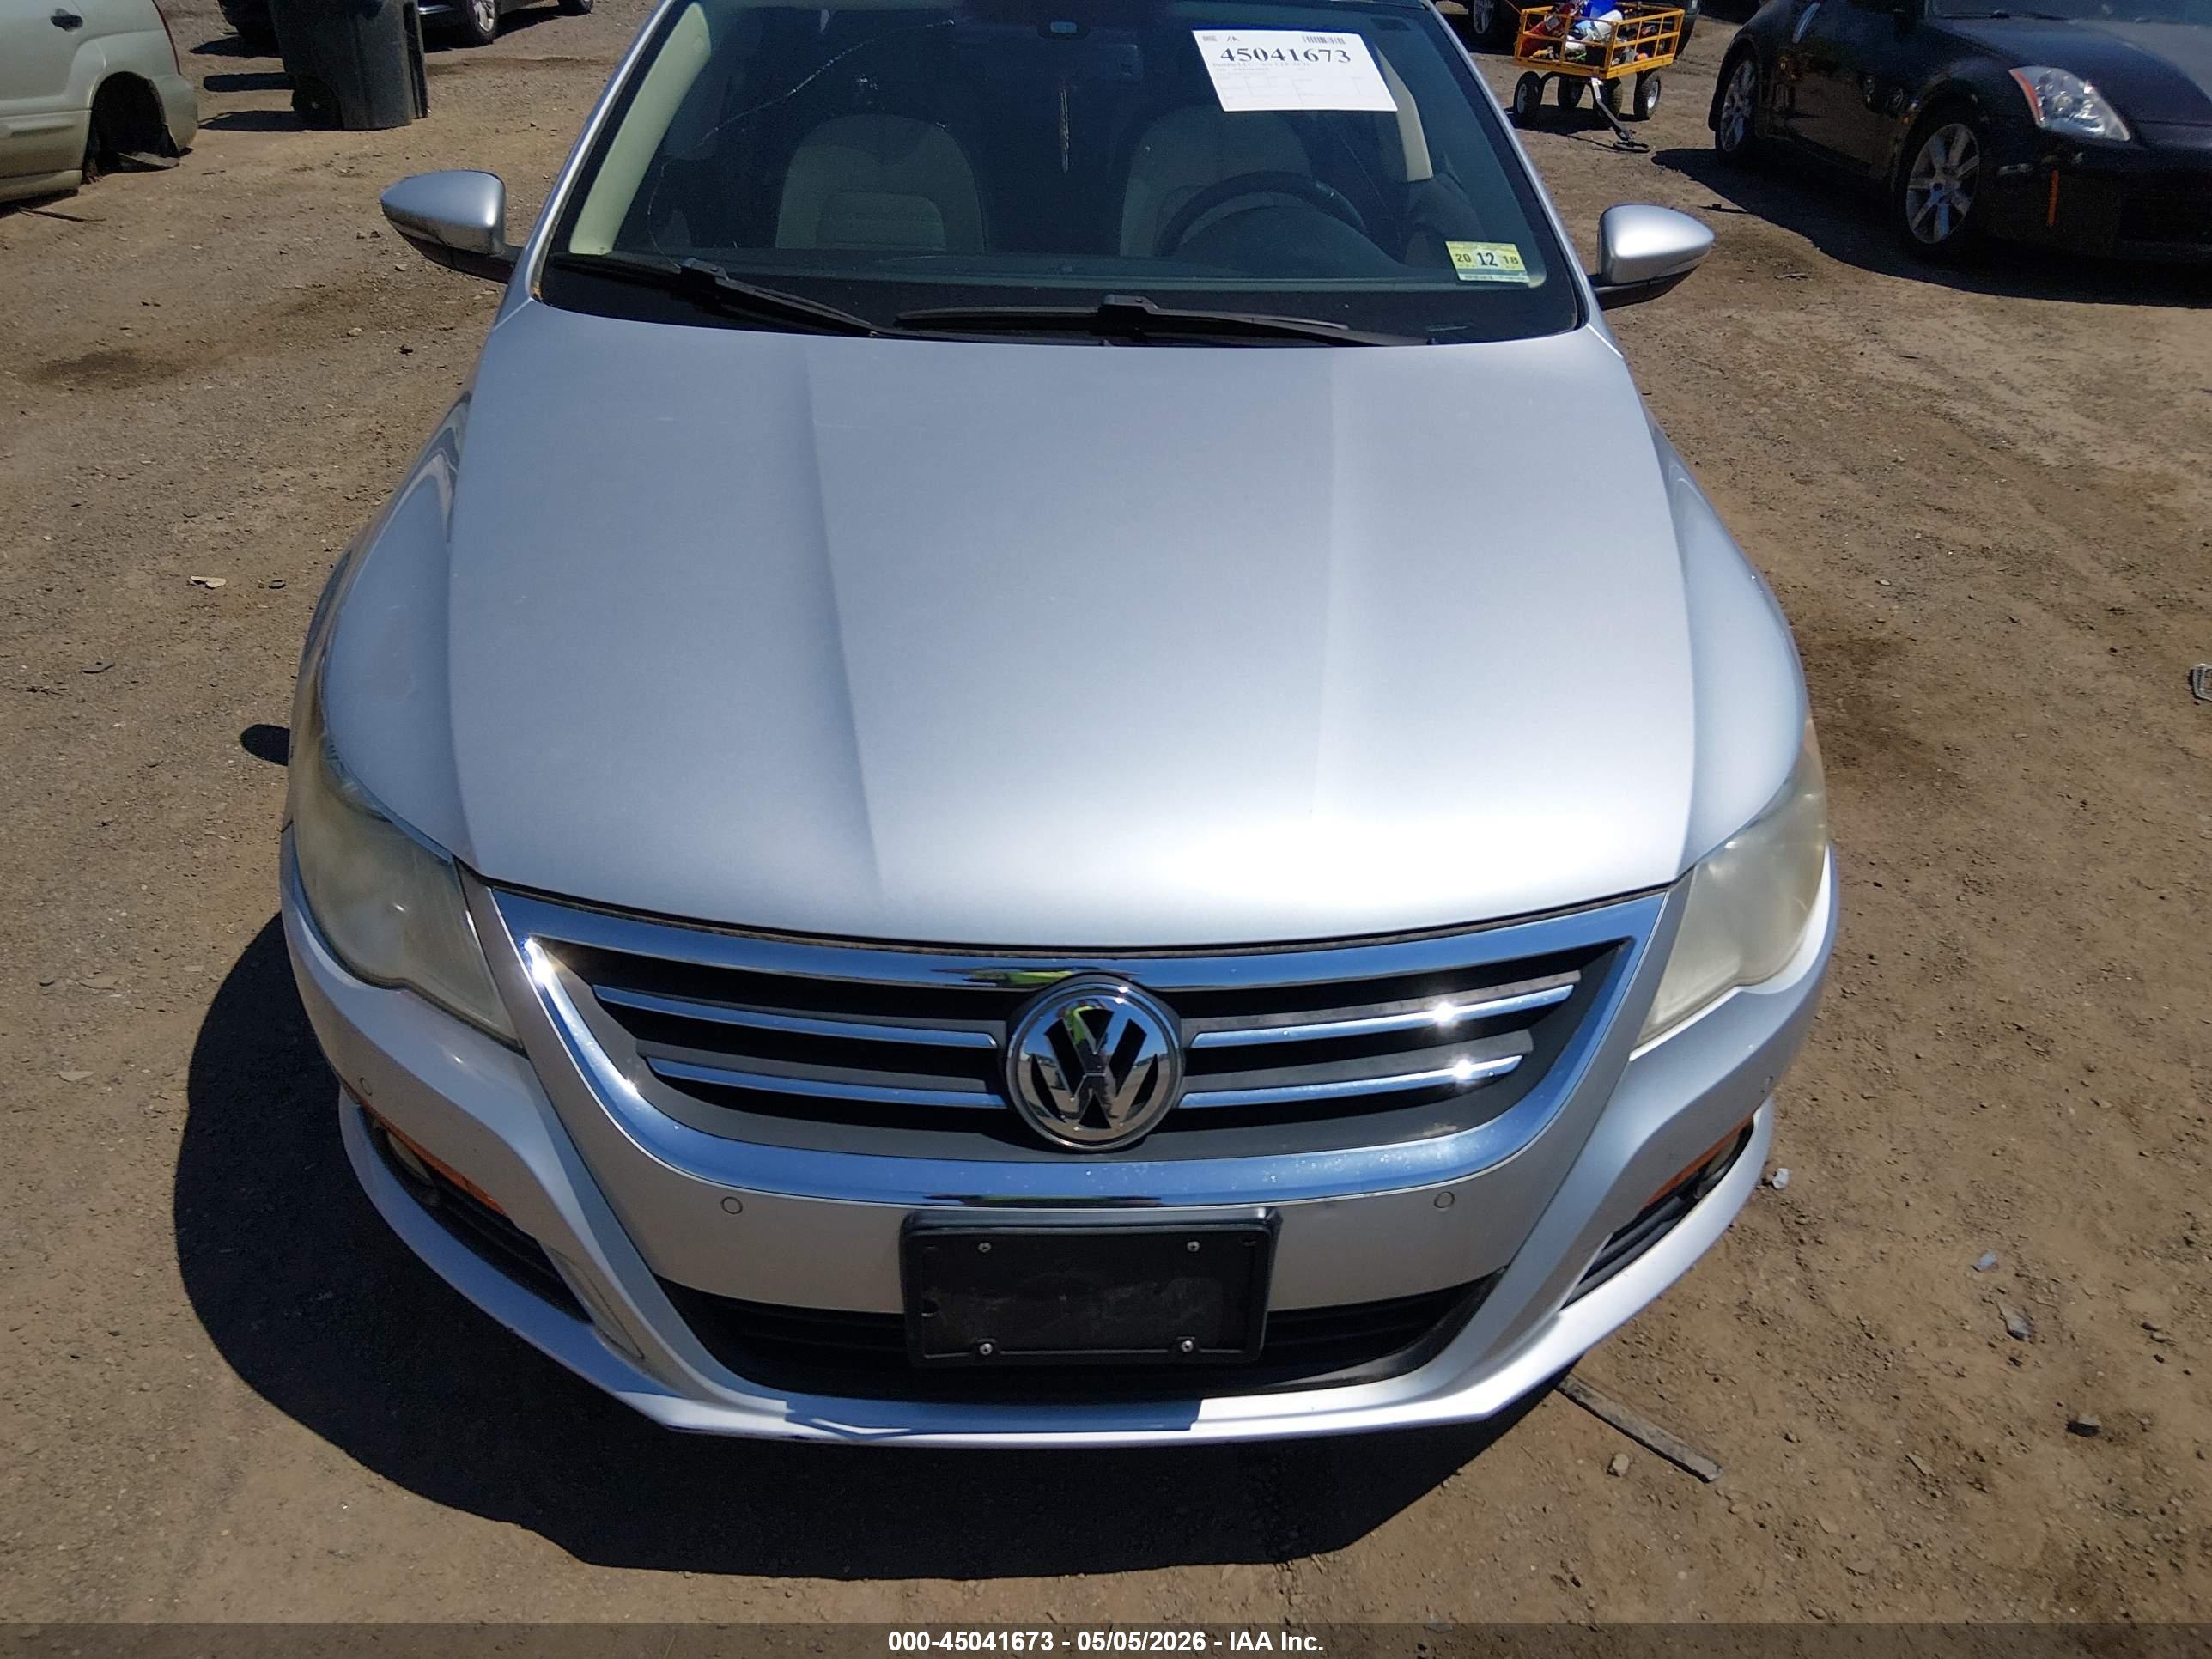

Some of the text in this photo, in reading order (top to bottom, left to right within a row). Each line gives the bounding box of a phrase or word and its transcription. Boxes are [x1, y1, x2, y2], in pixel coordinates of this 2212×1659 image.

[1220, 47, 1352, 63] 45041673
[1455, 252, 1519, 267] 20 12 18
